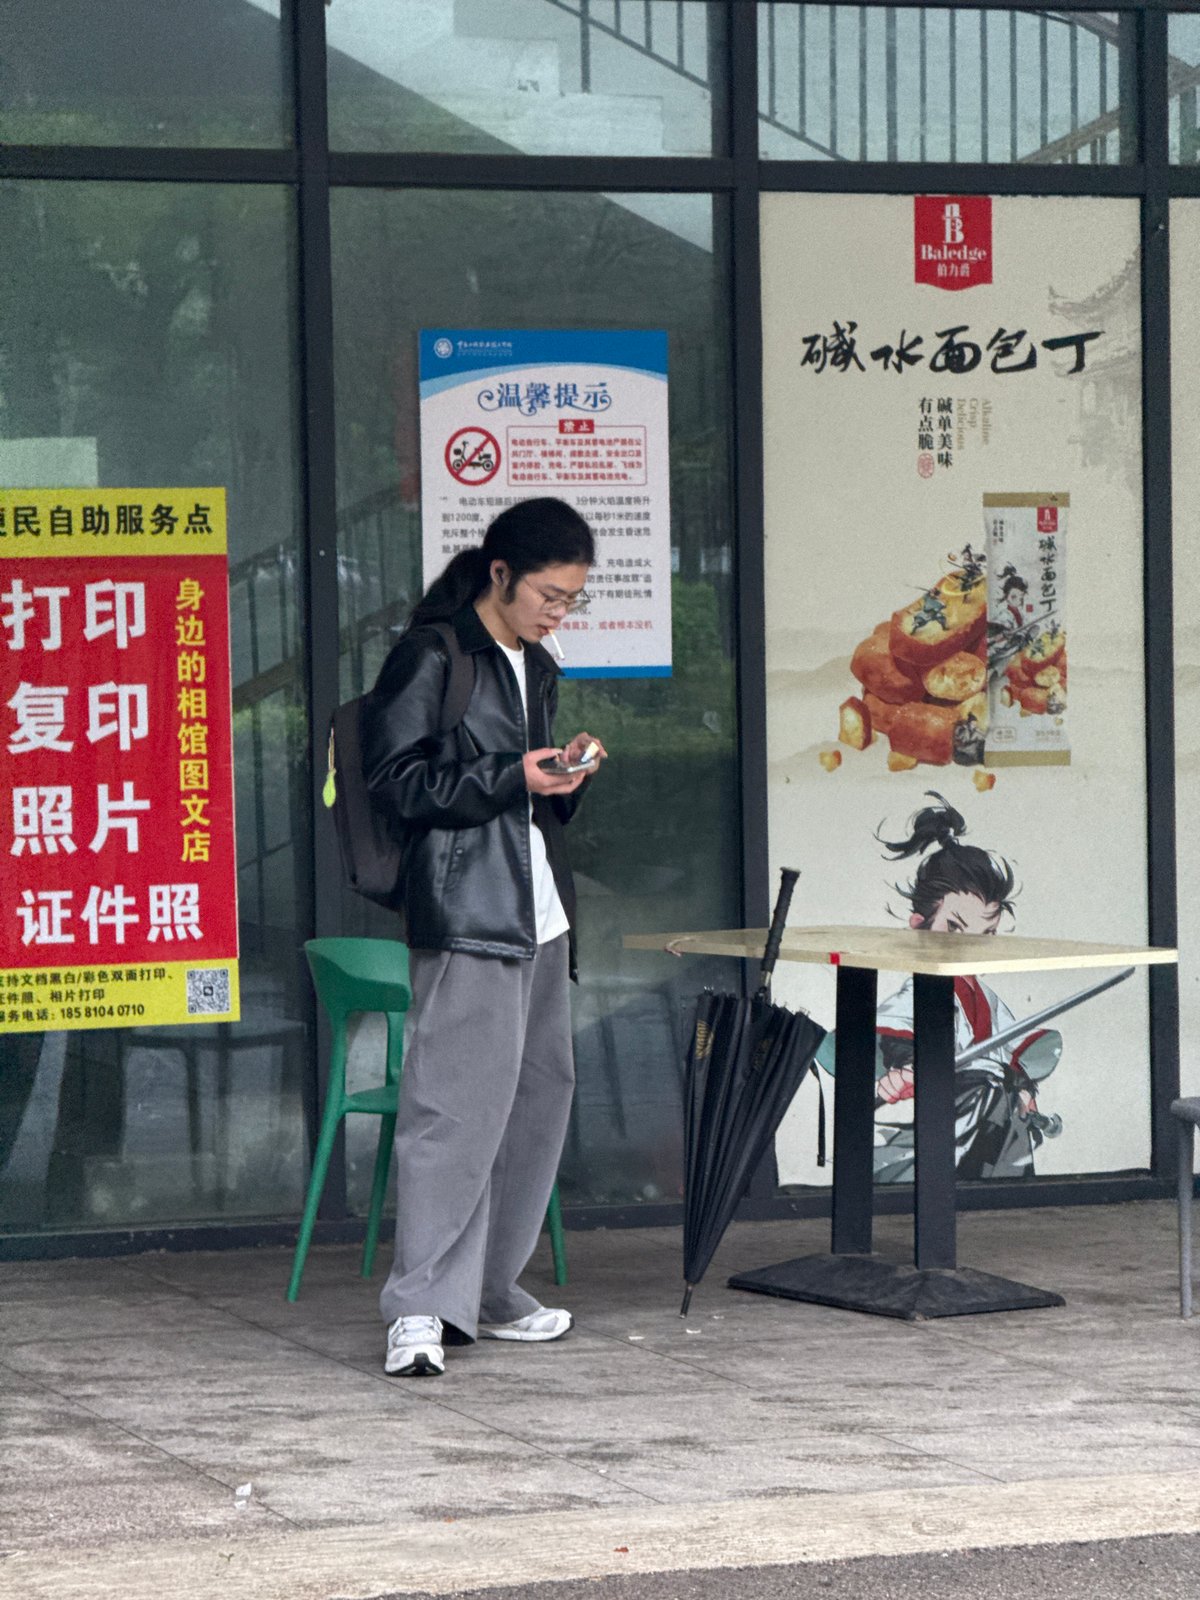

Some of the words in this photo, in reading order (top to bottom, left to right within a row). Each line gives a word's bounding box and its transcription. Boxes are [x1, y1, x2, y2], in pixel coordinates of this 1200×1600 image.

[920, 244, 987, 263] Baledge
[801, 320, 1106, 374] 碱水面包丁
[477, 382, 612, 416] 温馨提示
[968, 398, 978, 428] Crisp
[982, 399, 993, 445] Alkaline
[563, 421, 591, 432] 禁止
[918, 397, 934, 450] 有点脆
[0, 503, 213, 538] 民自助服务点
[2, 578, 146, 652] 打印
[7, 681, 149, 754] 复印
[175, 577, 211, 863] 身边的相馆图文店
[10, 781, 150, 857] 照片
[16, 883, 203, 946] 证件照
[0, 968, 174, 987] 持文档黑白/彩色双面打印、
[60, 1006, 82, 1020] 185
[84, 1005, 115, 1018] 8104
[117, 1003, 145, 1017] 0710
